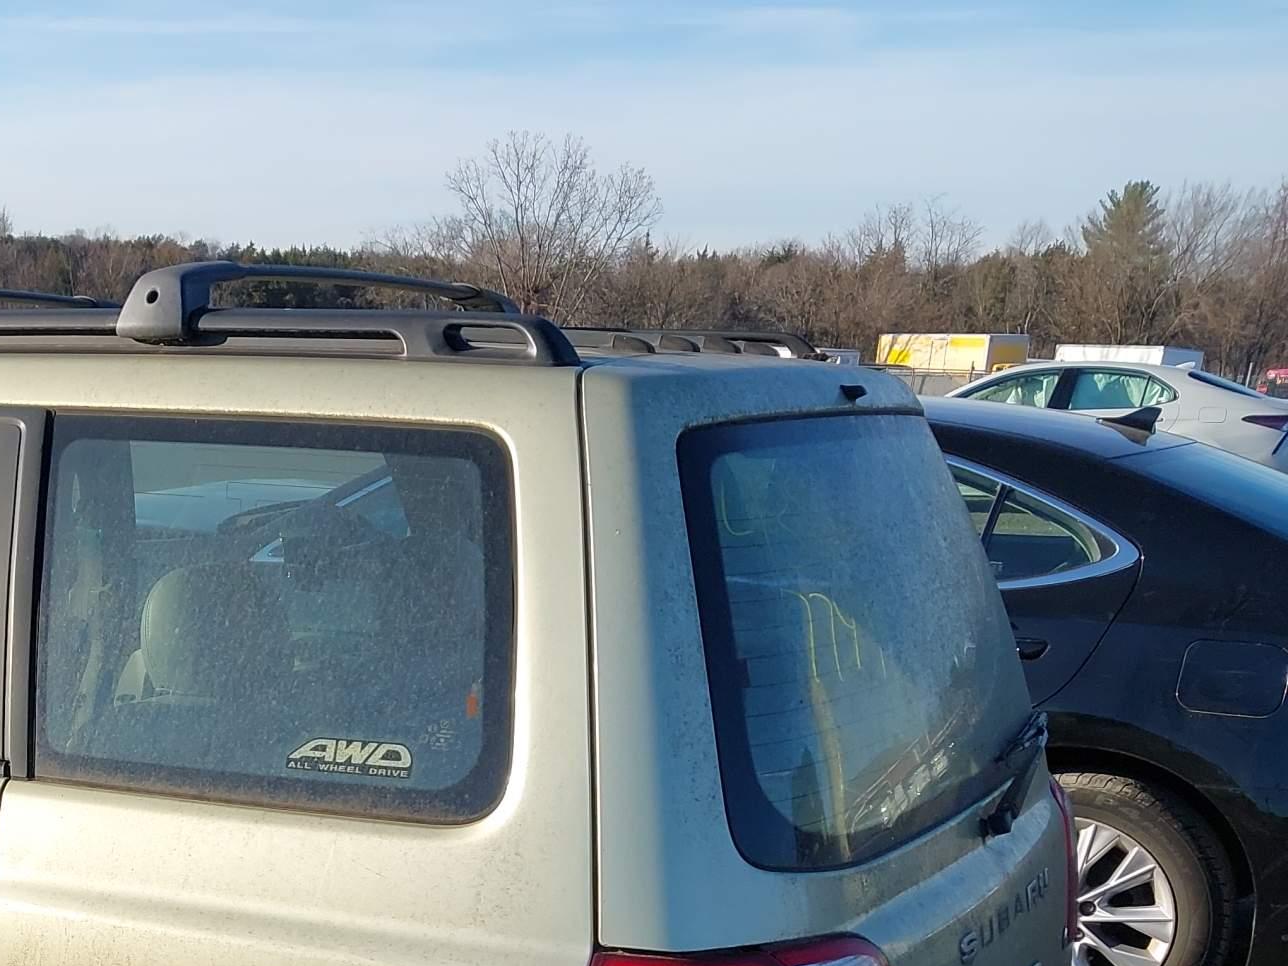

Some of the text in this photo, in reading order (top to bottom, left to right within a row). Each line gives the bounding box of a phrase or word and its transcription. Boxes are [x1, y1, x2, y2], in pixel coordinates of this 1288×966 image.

[288, 738, 412, 768] AWD
[288, 761, 409, 777] ALL WHEEL DRIVE
[958, 866, 1050, 965] SUBARU
